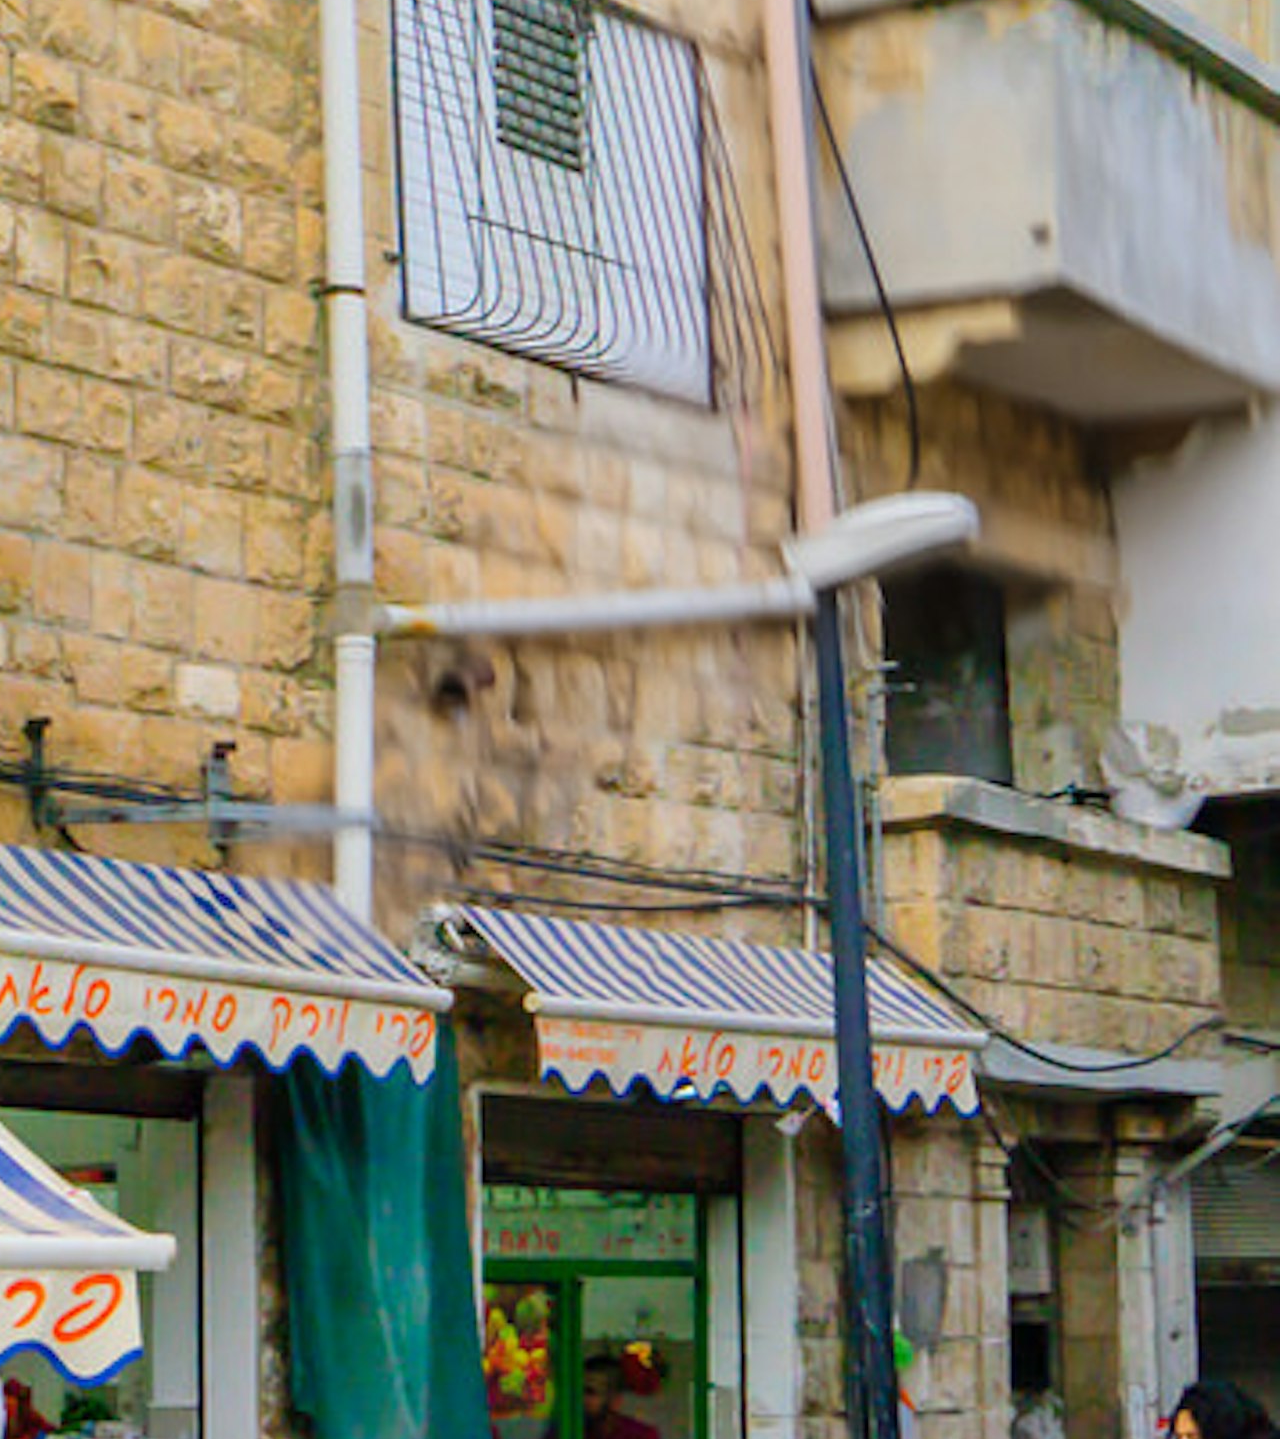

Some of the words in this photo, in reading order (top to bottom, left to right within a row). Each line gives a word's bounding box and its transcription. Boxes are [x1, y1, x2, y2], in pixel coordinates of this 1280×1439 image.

[141, 978, 239, 1034] סמרי
[268, 996, 349, 1052] וירק
[374, 1008, 436, 1059] פרי
[757, 1046, 827, 1082] סמרי
[924, 1053, 968, 1095] פרי
